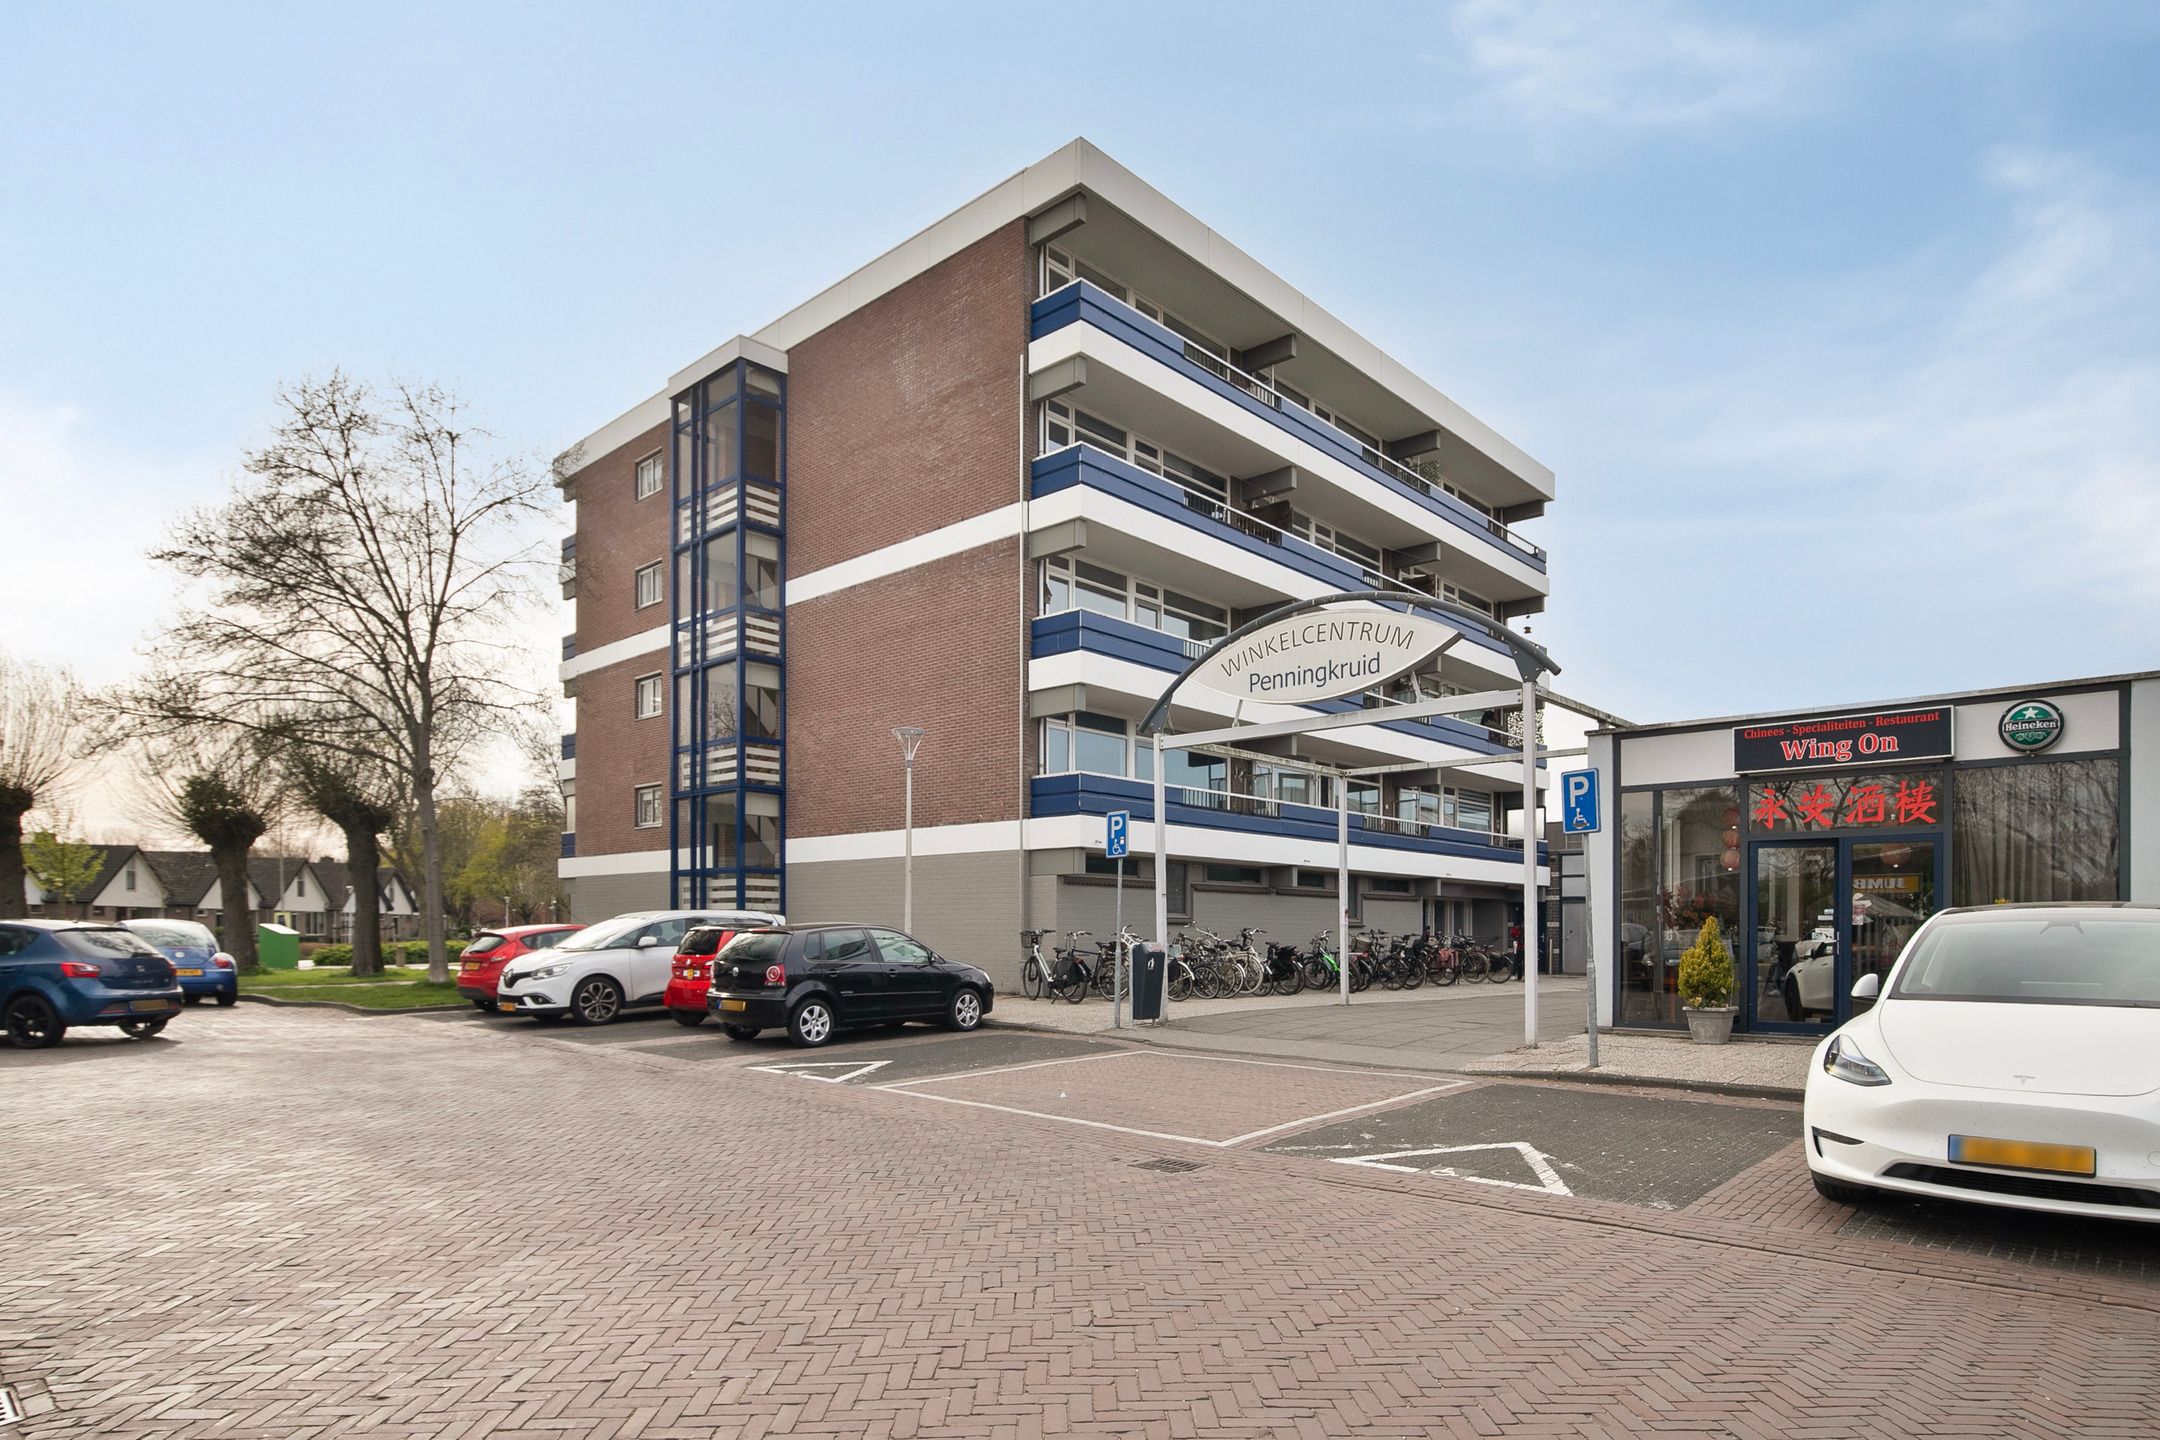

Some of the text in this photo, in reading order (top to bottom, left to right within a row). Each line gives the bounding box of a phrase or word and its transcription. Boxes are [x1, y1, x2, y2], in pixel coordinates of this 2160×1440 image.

[1221, 621, 1414, 677] WINKELCENTRUM
[1250, 652, 1380, 693] Penningkruid
[1744, 728, 1784, 739] Chinees
[1793, 720, 1866, 736] Specialiteiten
[1876, 712, 1940, 726] Restaurant
[2005, 721, 2056, 731] Heineken
[1780, 733, 1899, 761] Wing On
[1569, 776, 1589, 807] P
[1754, 779, 1937, 829] 永安酒樓
[1111, 816, 1123, 839] P
